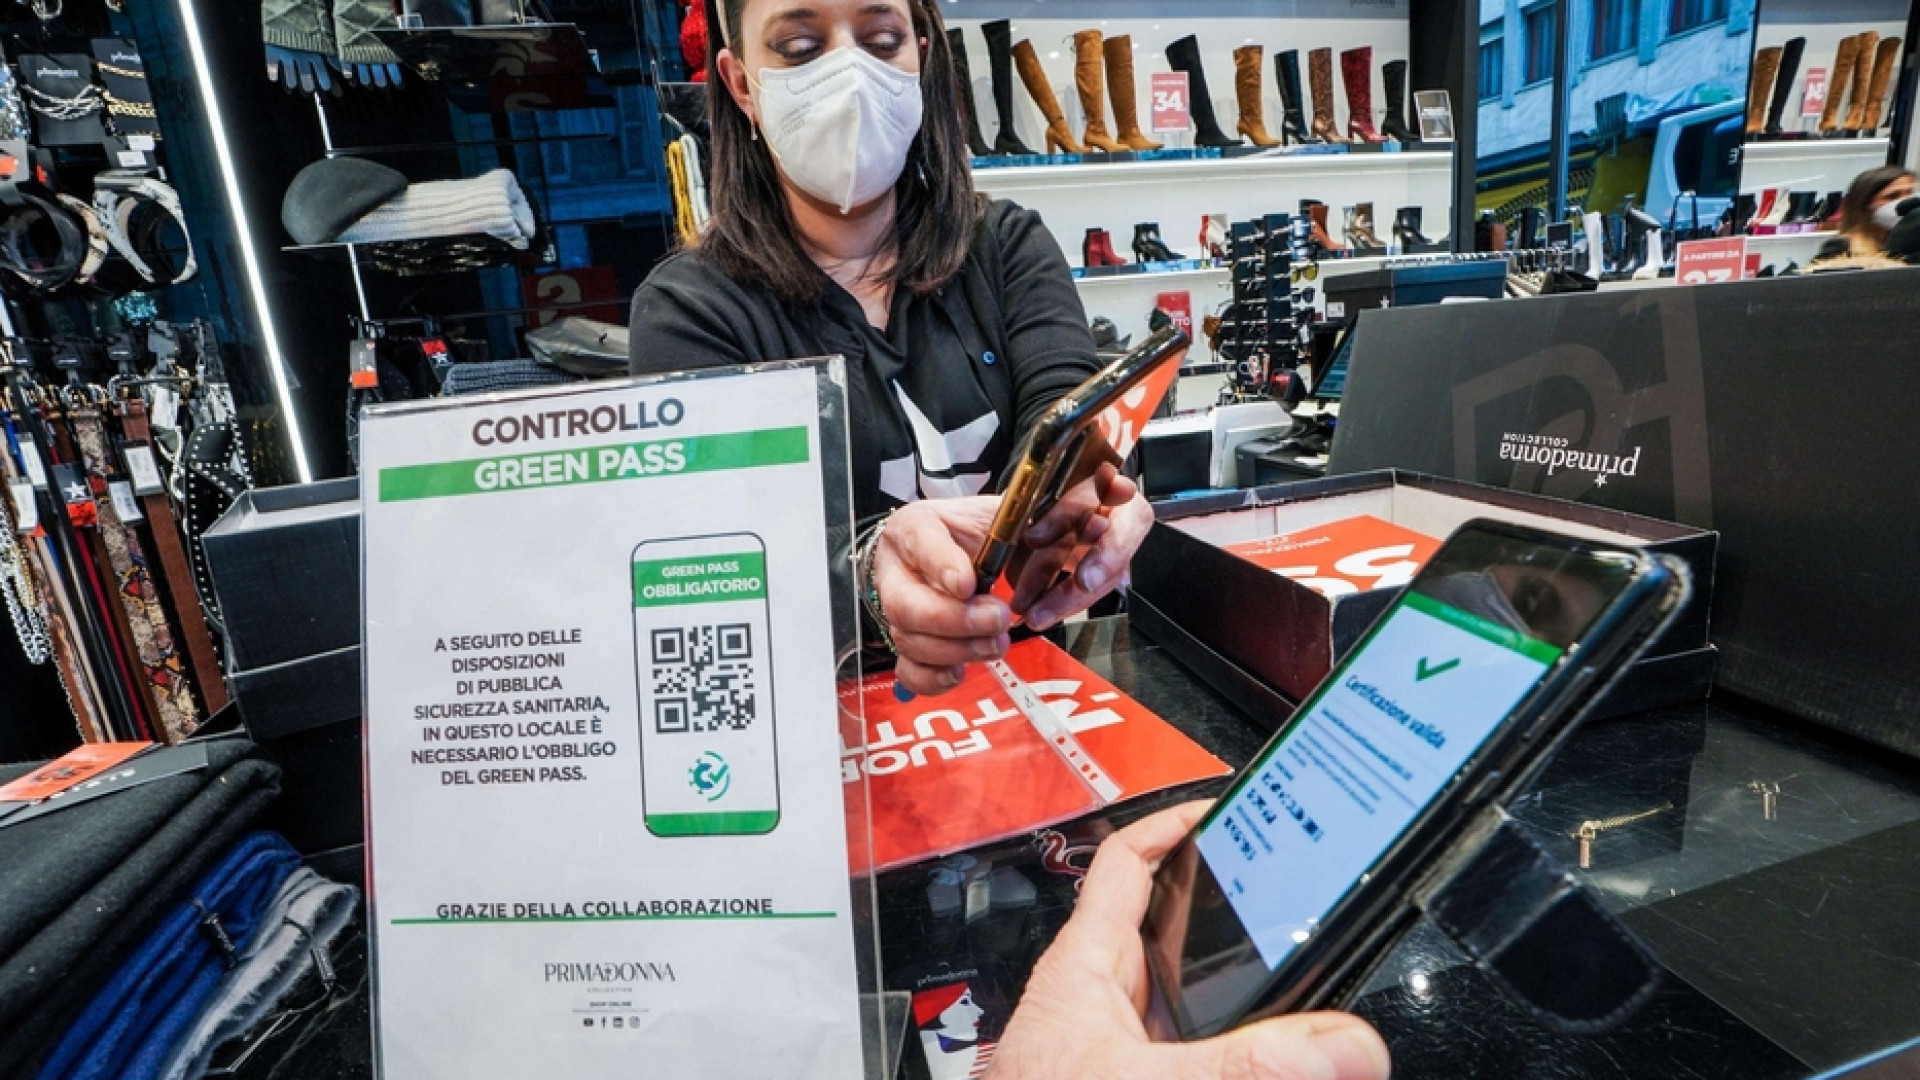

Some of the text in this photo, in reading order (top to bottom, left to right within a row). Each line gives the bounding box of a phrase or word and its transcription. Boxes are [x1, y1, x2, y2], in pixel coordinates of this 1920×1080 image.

[472, 397, 685, 446] CONTROLLO
[1502, 431, 1569, 447] COLLECTION
[474, 442, 686, 490] GREEN PASS
[1499, 441, 1641, 487] primadonna
[662, 561, 740, 578] GREEN PASS
[642, 577, 761, 599] OBBLIGATORIO
[434, 628, 582, 652] A SEGUITO DELLE
[452, 652, 565, 673] DISPOSIZIONI
[456, 675, 563, 696] DI PUBBLICA
[414, 696, 610, 720] SICUREZZA SANITARIA,
[1345, 674, 1410, 725] Certificazione
[1408, 718, 1446, 749] valida
[423, 716, 602, 741] IN QUESTO LOCALE È
[411, 741, 616, 765] NECESSARIO L'OBBLIGO
[441, 765, 587, 785] DEL GREEN PASS.
[436, 898, 773, 919] GRAZIE DELLA COLLABORAZIONE
[544, 962, 676, 982] PRIMADONNA
